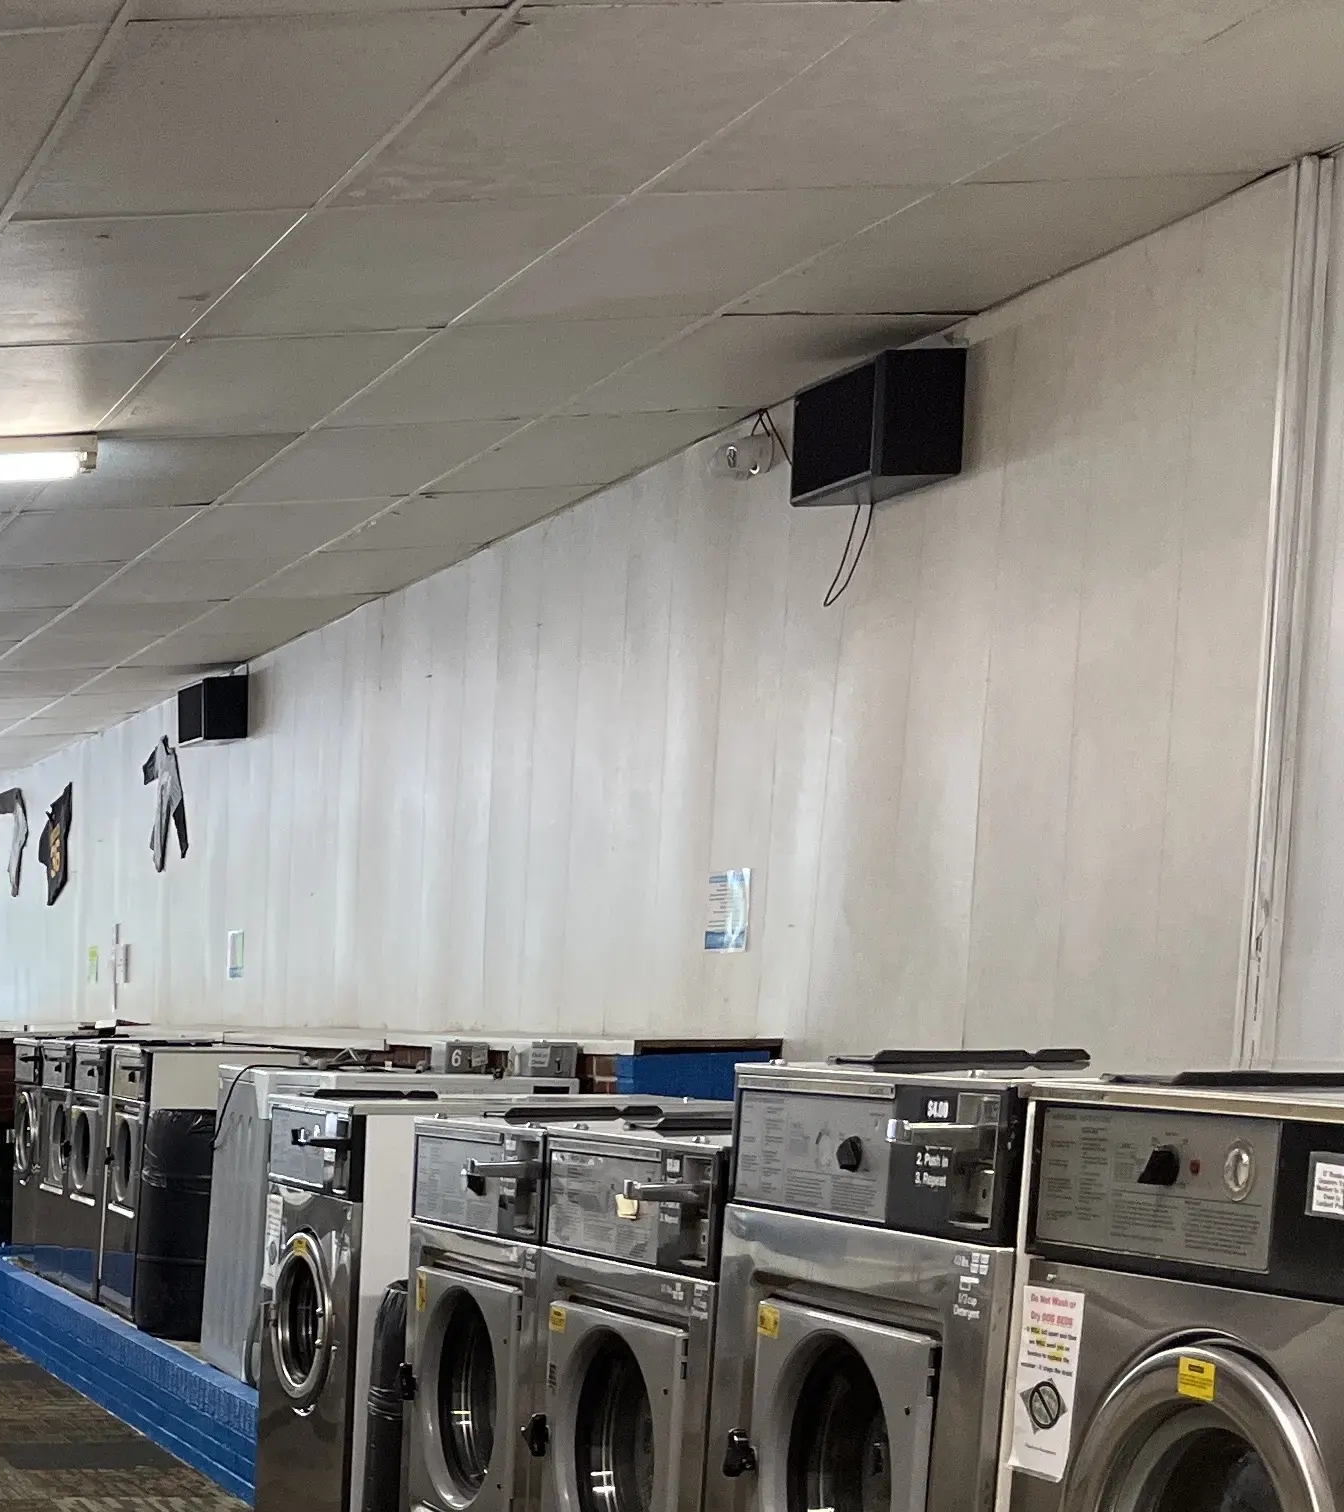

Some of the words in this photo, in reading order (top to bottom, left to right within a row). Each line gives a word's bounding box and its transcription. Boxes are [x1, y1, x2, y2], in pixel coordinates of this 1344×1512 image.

[451, 1049, 462, 1067] 6
[927, 1100, 949, 1118] $4.00
[924, 1153, 941, 1167] Push
[923, 1172, 947, 1188] Repeat
[1031, 1293, 1039, 1302] Do
[1040, 1295, 1051, 1305] Not
[1052, 1297, 1068, 1307] Wash
[953, 1304, 980, 1320] Detergent
[1031, 1311, 1041, 1323] Dry
